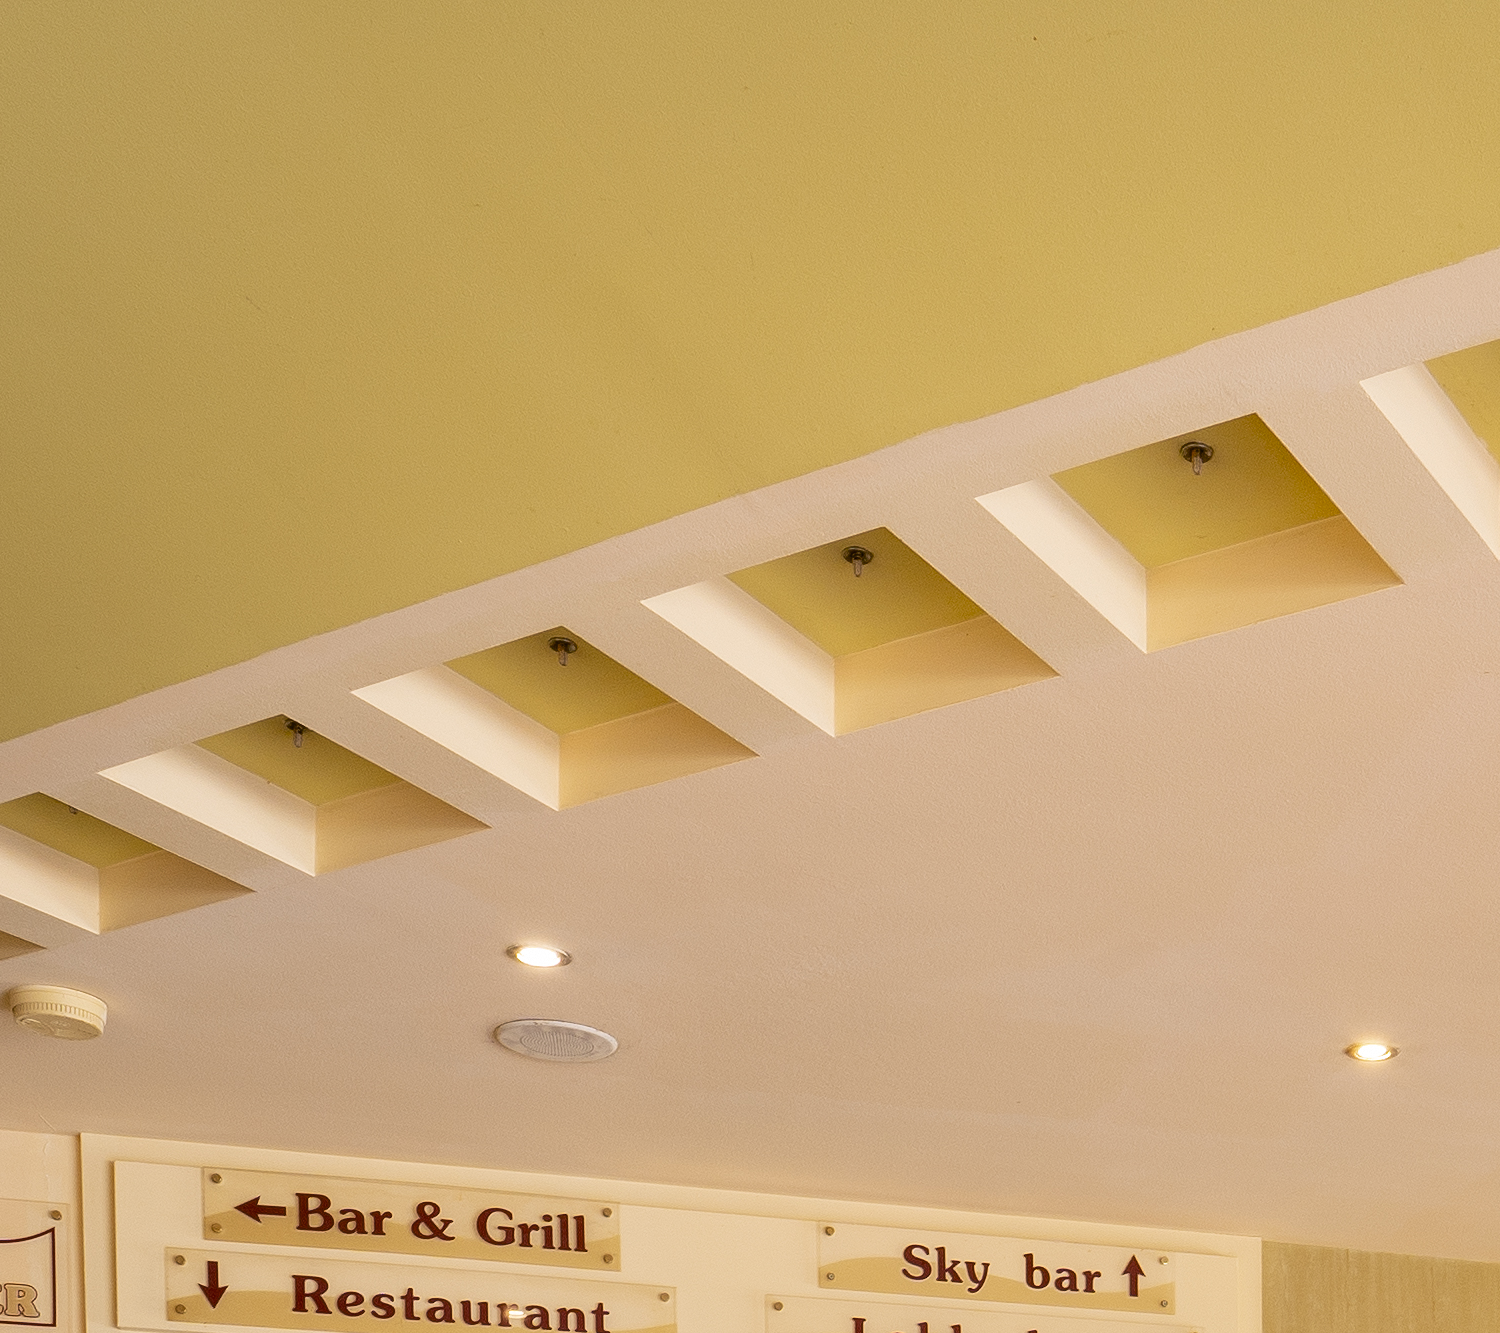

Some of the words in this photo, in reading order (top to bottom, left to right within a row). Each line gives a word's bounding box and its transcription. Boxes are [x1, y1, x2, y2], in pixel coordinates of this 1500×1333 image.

[294, 1191, 393, 1236] Bar
[410, 1201, 456, 1242] &
[475, 1207, 588, 1253] Grill
[901, 1244, 991, 1294] Sky
[1024, 1252, 1102, 1294] bar
